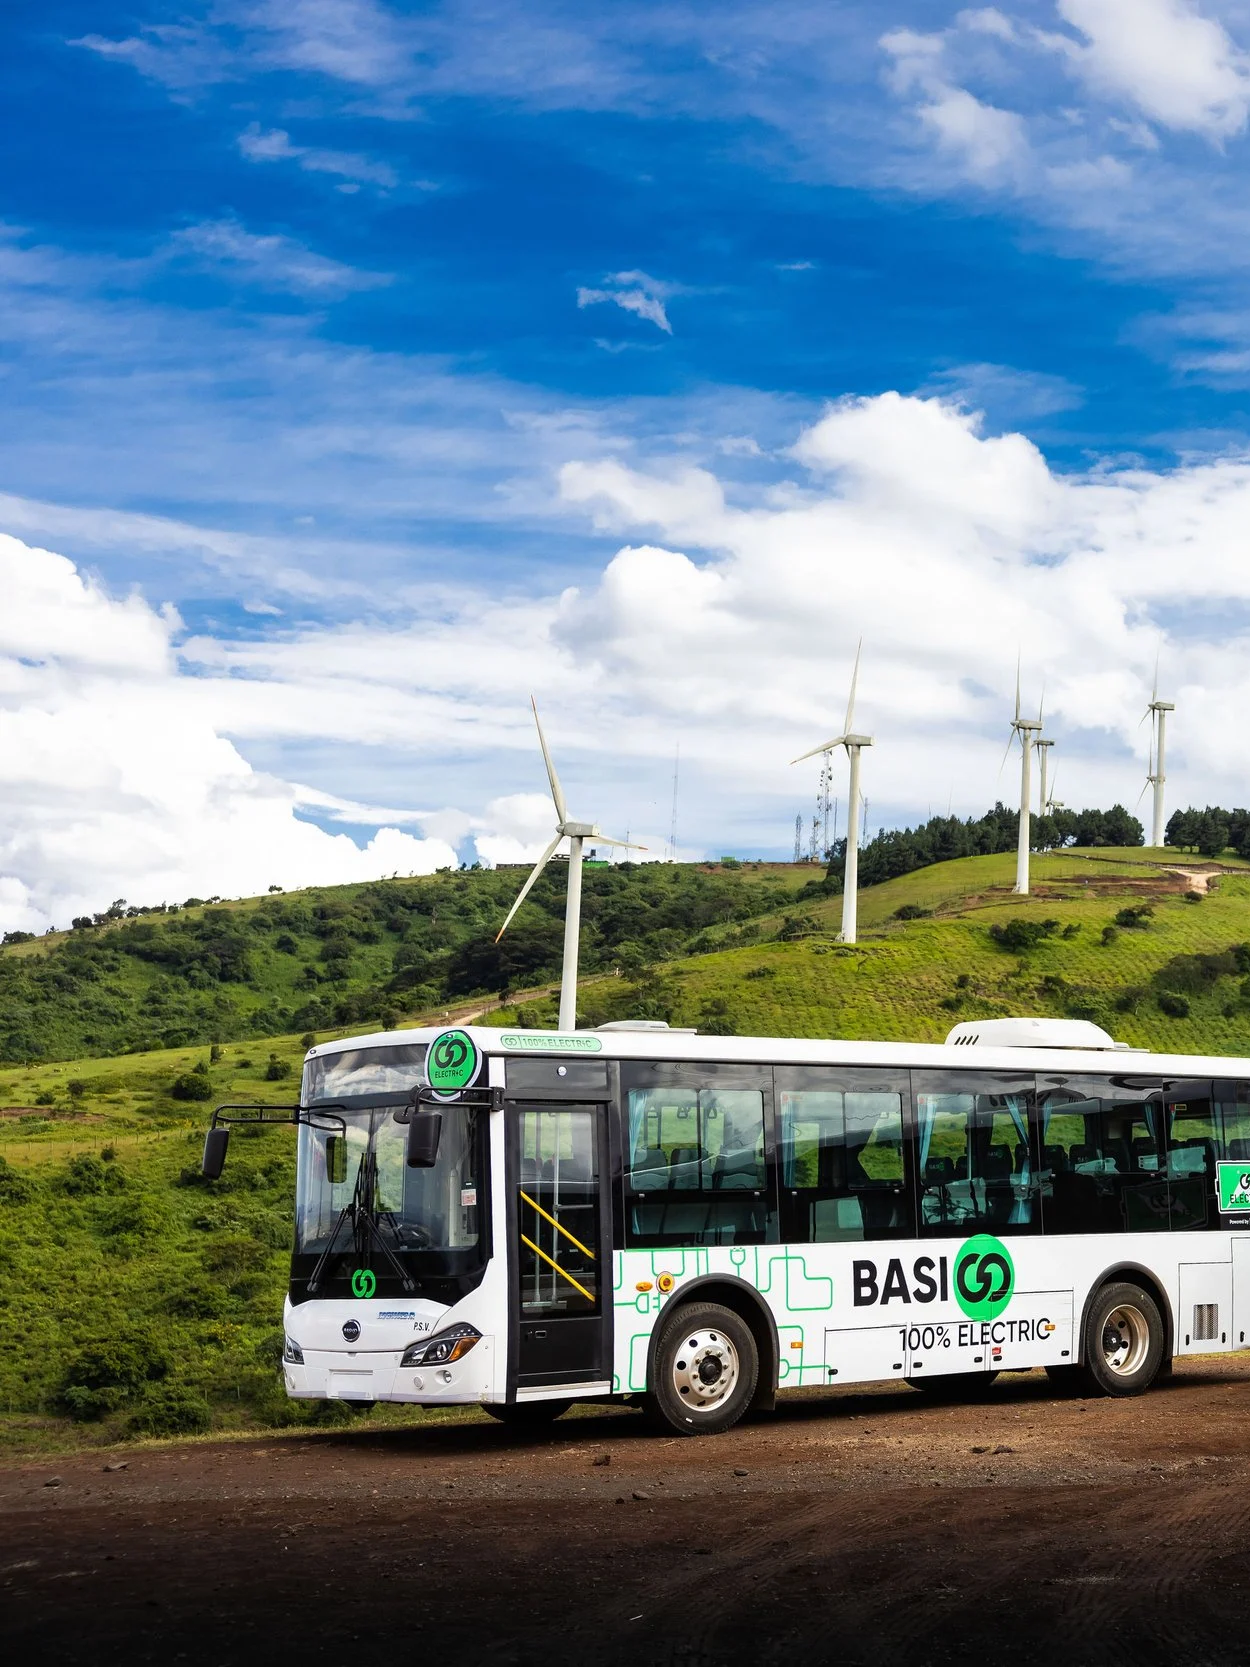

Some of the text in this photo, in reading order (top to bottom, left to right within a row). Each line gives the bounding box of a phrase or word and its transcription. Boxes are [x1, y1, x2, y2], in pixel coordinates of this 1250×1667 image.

[522, 1037, 547, 1047] 100%
[413, 1321, 430, 1332] P.S.V.
[899, 1317, 1051, 1352] 100% ELECTRIC
